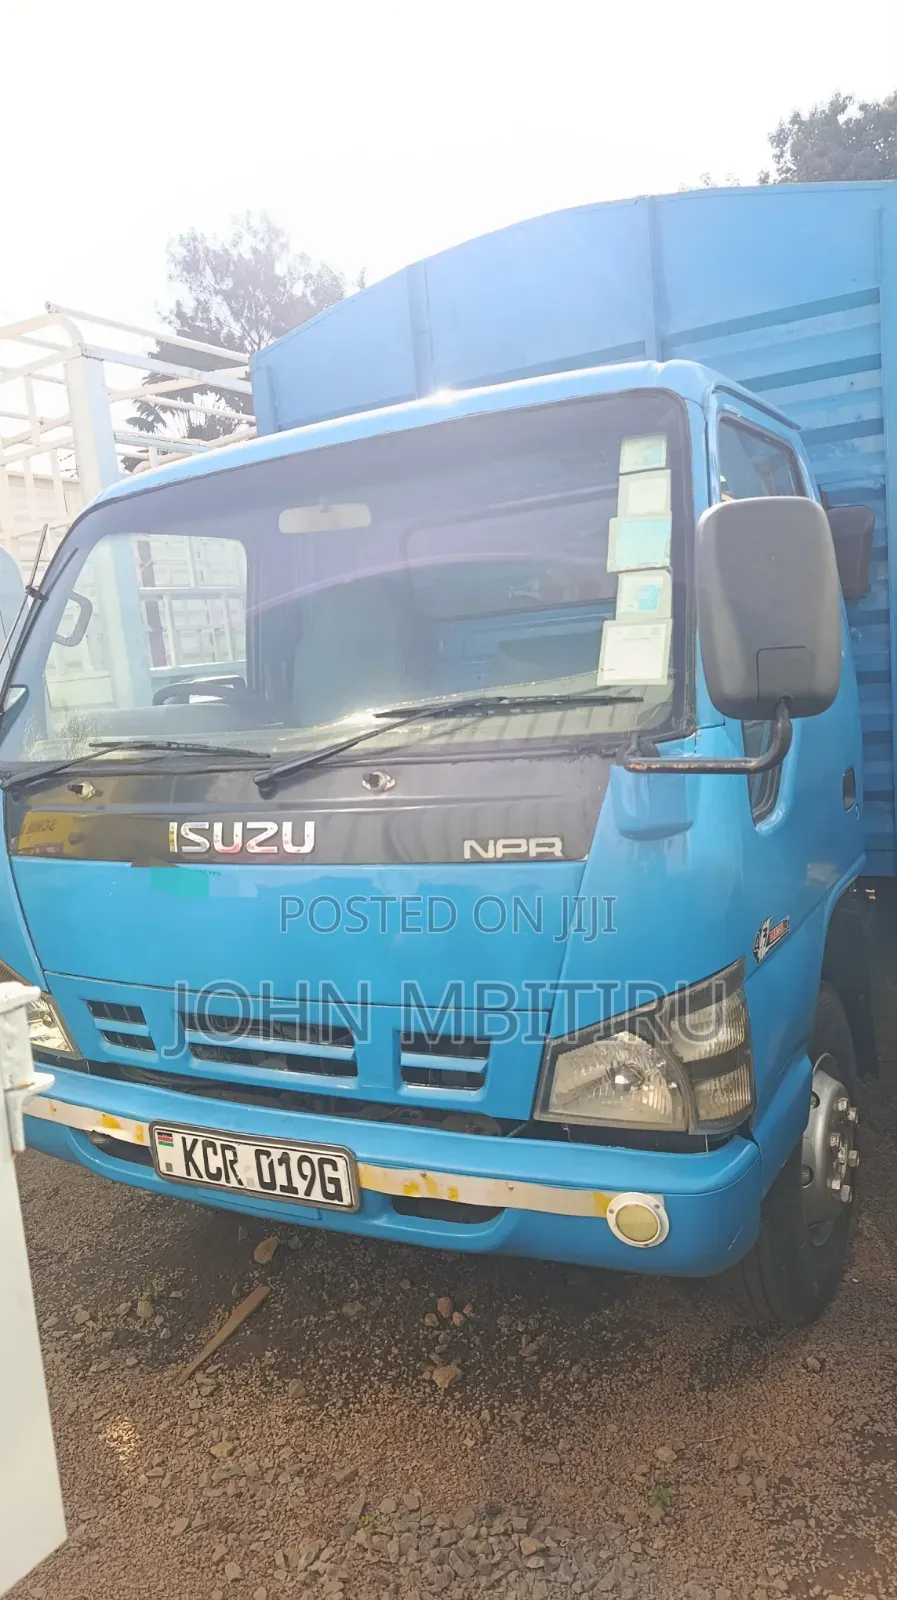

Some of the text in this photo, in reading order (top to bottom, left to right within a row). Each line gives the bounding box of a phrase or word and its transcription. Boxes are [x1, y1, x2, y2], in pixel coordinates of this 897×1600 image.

[168, 821, 315, 854] ISUZU
[463, 836, 563, 860] NPR
[181, 1136, 244, 1187] KCR
[254, 1148, 344, 1203] 019G
